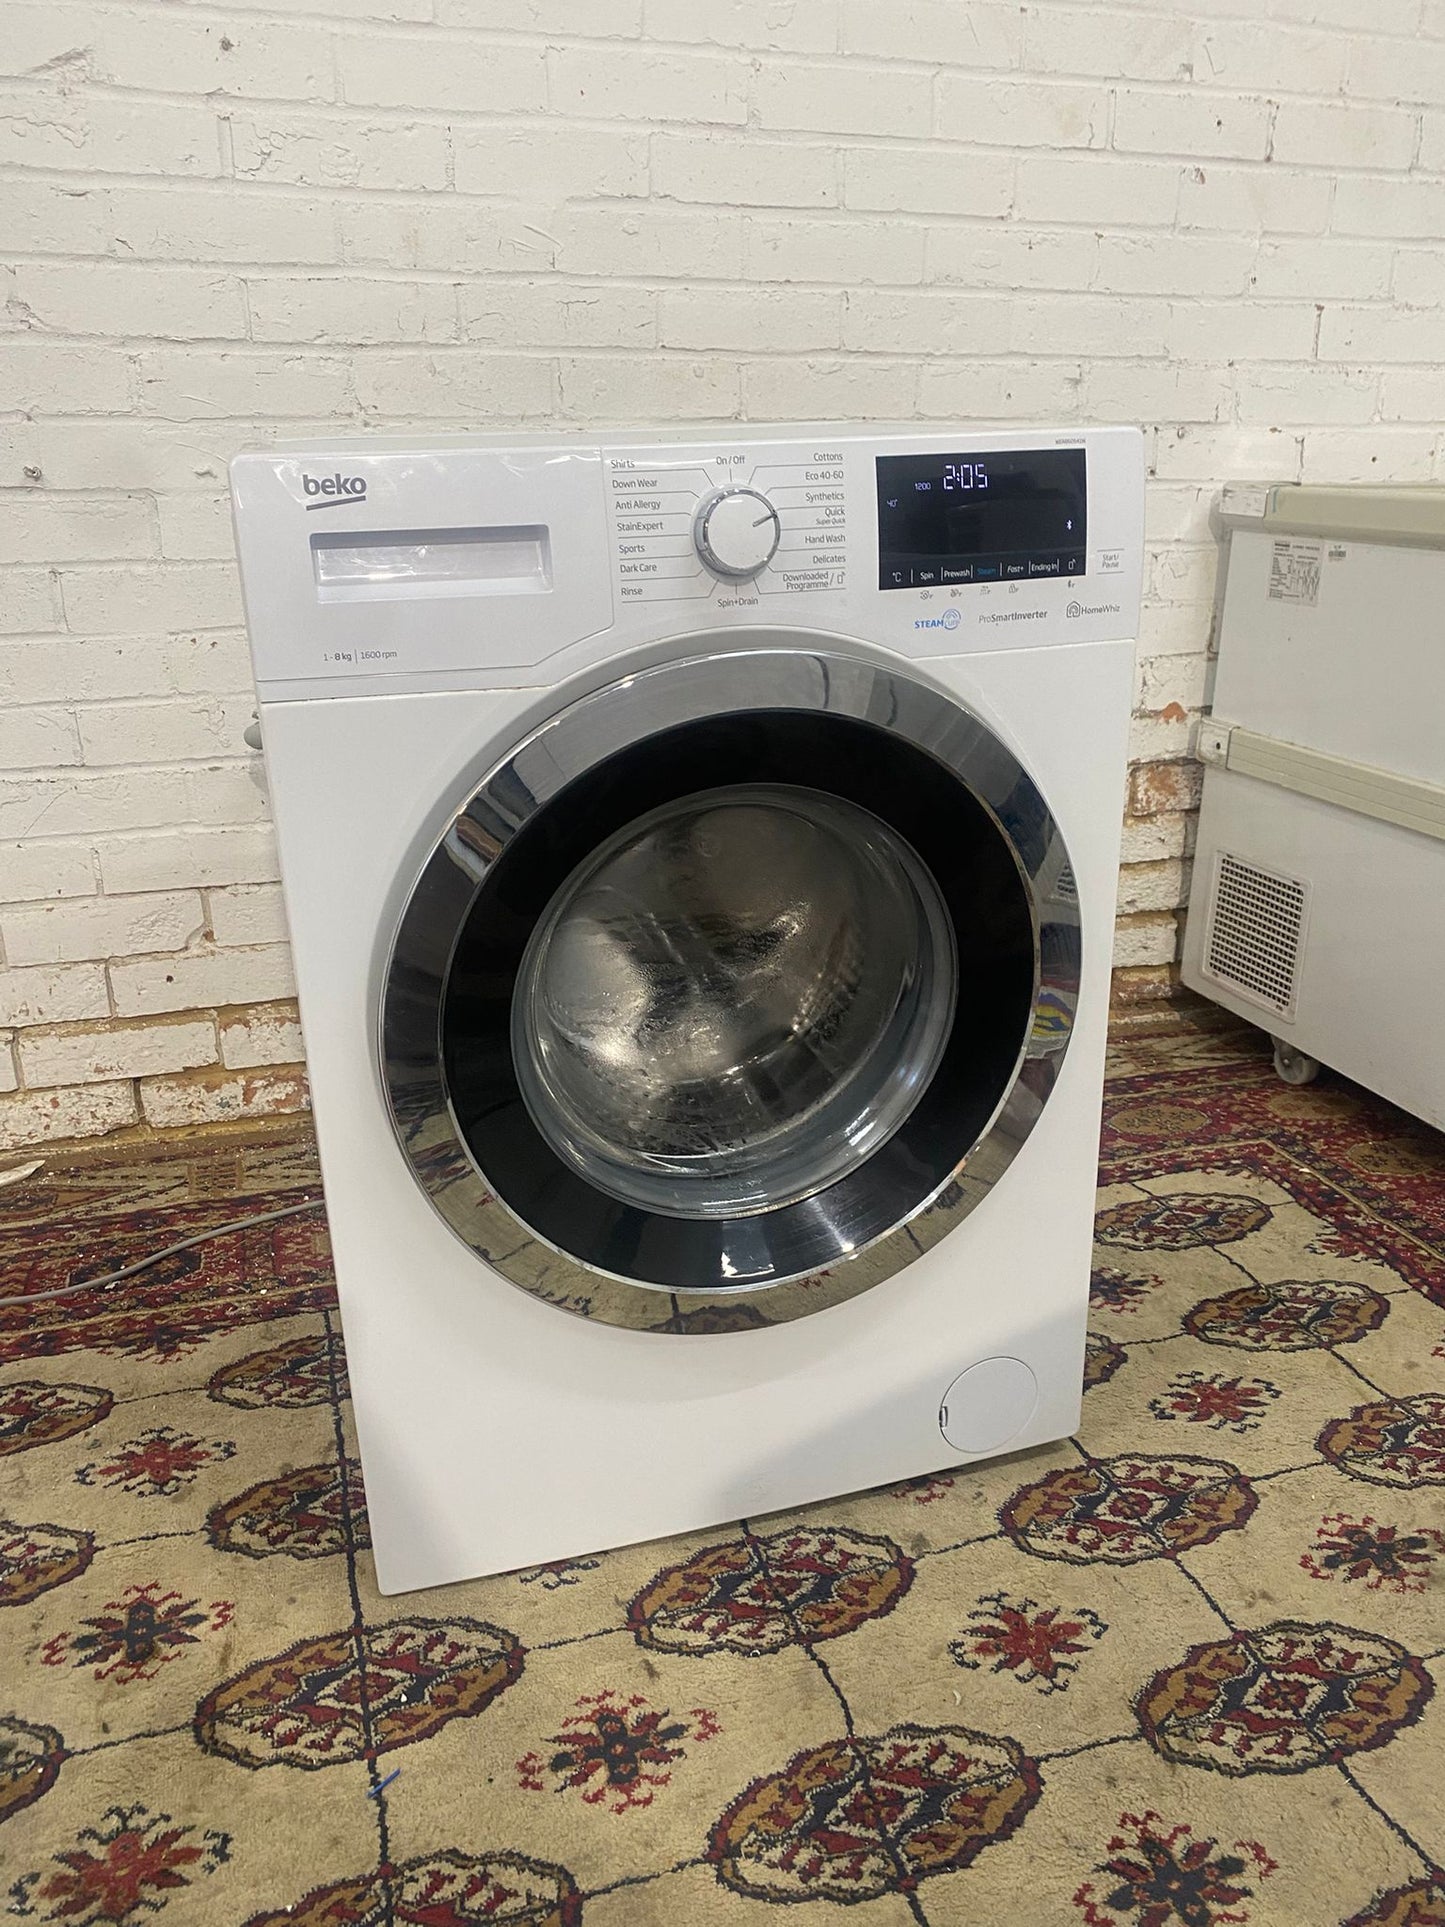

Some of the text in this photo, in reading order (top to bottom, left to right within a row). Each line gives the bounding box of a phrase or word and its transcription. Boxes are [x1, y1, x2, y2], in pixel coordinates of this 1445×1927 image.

[716, 456, 728, 465] On
[733, 456, 745, 464] Off
[814, 452, 843, 462] Cottons
[610, 460, 635, 469] Shirts
[806, 470, 844, 480] Eco 40-60
[943, 464, 988, 490] 2:05
[302, 474, 366, 496] beko
[612, 479, 658, 488] Down Wear
[914, 482, 931, 490] 1200
[806, 492, 844, 503] Synthetics
[616, 500, 661, 510] Anti Allergy
[825, 508, 845, 517] Quick
[617, 522, 663, 532] StainExpert
[805, 534, 845, 544] Hand Wash
[619, 544, 645, 554] Sports
[813, 555, 846, 564] Delicates
[620, 564, 657, 573] Dark Care
[1007, 564, 1024, 573] Fast+
[1031, 562, 1050, 573] Ending
[783, 572, 829, 582] Downloaded
[920, 571, 934, 581] Spin
[944, 570, 970, 579] Prewash
[786, 580, 829, 591] Programme
[621, 587, 643, 596] Rinse
[717, 597, 758, 608] Spin+Drain
[1081, 604, 1120, 614] HomeWhiz
[979, 611, 1047, 624] ProSmartInverter
[342, 653, 352, 661] kg
[361, 651, 381, 659] 1600
